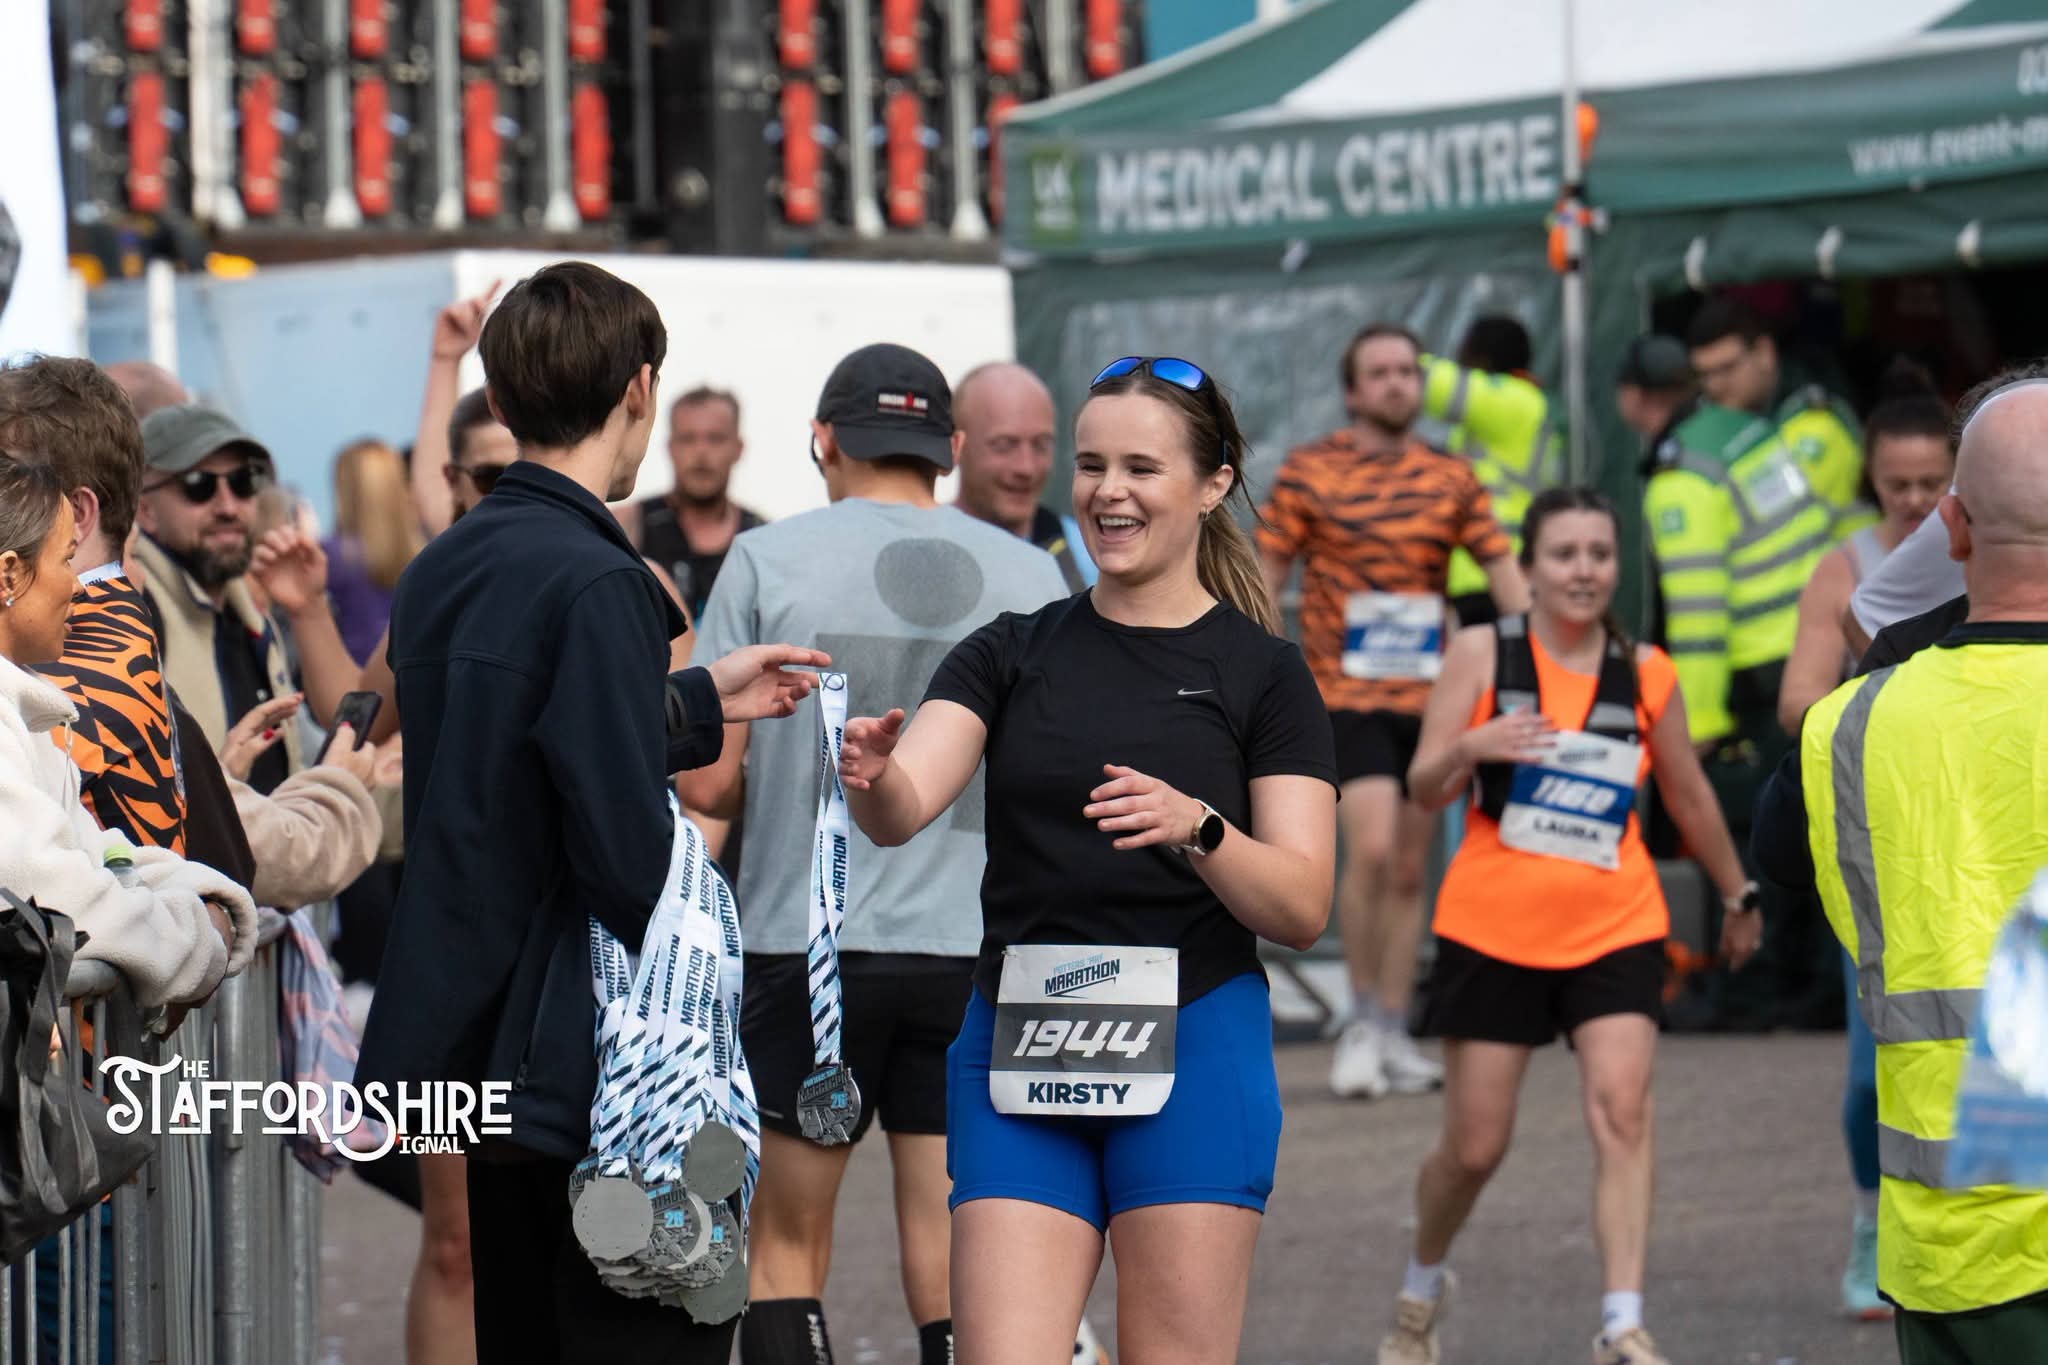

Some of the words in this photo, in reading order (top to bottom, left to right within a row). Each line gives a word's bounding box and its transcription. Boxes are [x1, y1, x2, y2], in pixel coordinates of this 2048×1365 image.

[1097, 140, 1328, 233] MEDICAL
[1336, 115, 1556, 217] CENTRE
[680, 825, 696, 901] MARATHON
[833, 834, 847, 912] MARATHON
[717, 879, 740, 957] MARATHON
[680, 945, 703, 1026] MARATHON
[697, 951, 717, 1032] MARATHON
[1045, 959, 1120, 994] MARATHON
[712, 999, 727, 1078] MARATHON
[1013, 1020, 1158, 1058] 1944
[1028, 1082, 1131, 1104] KIRSTY
